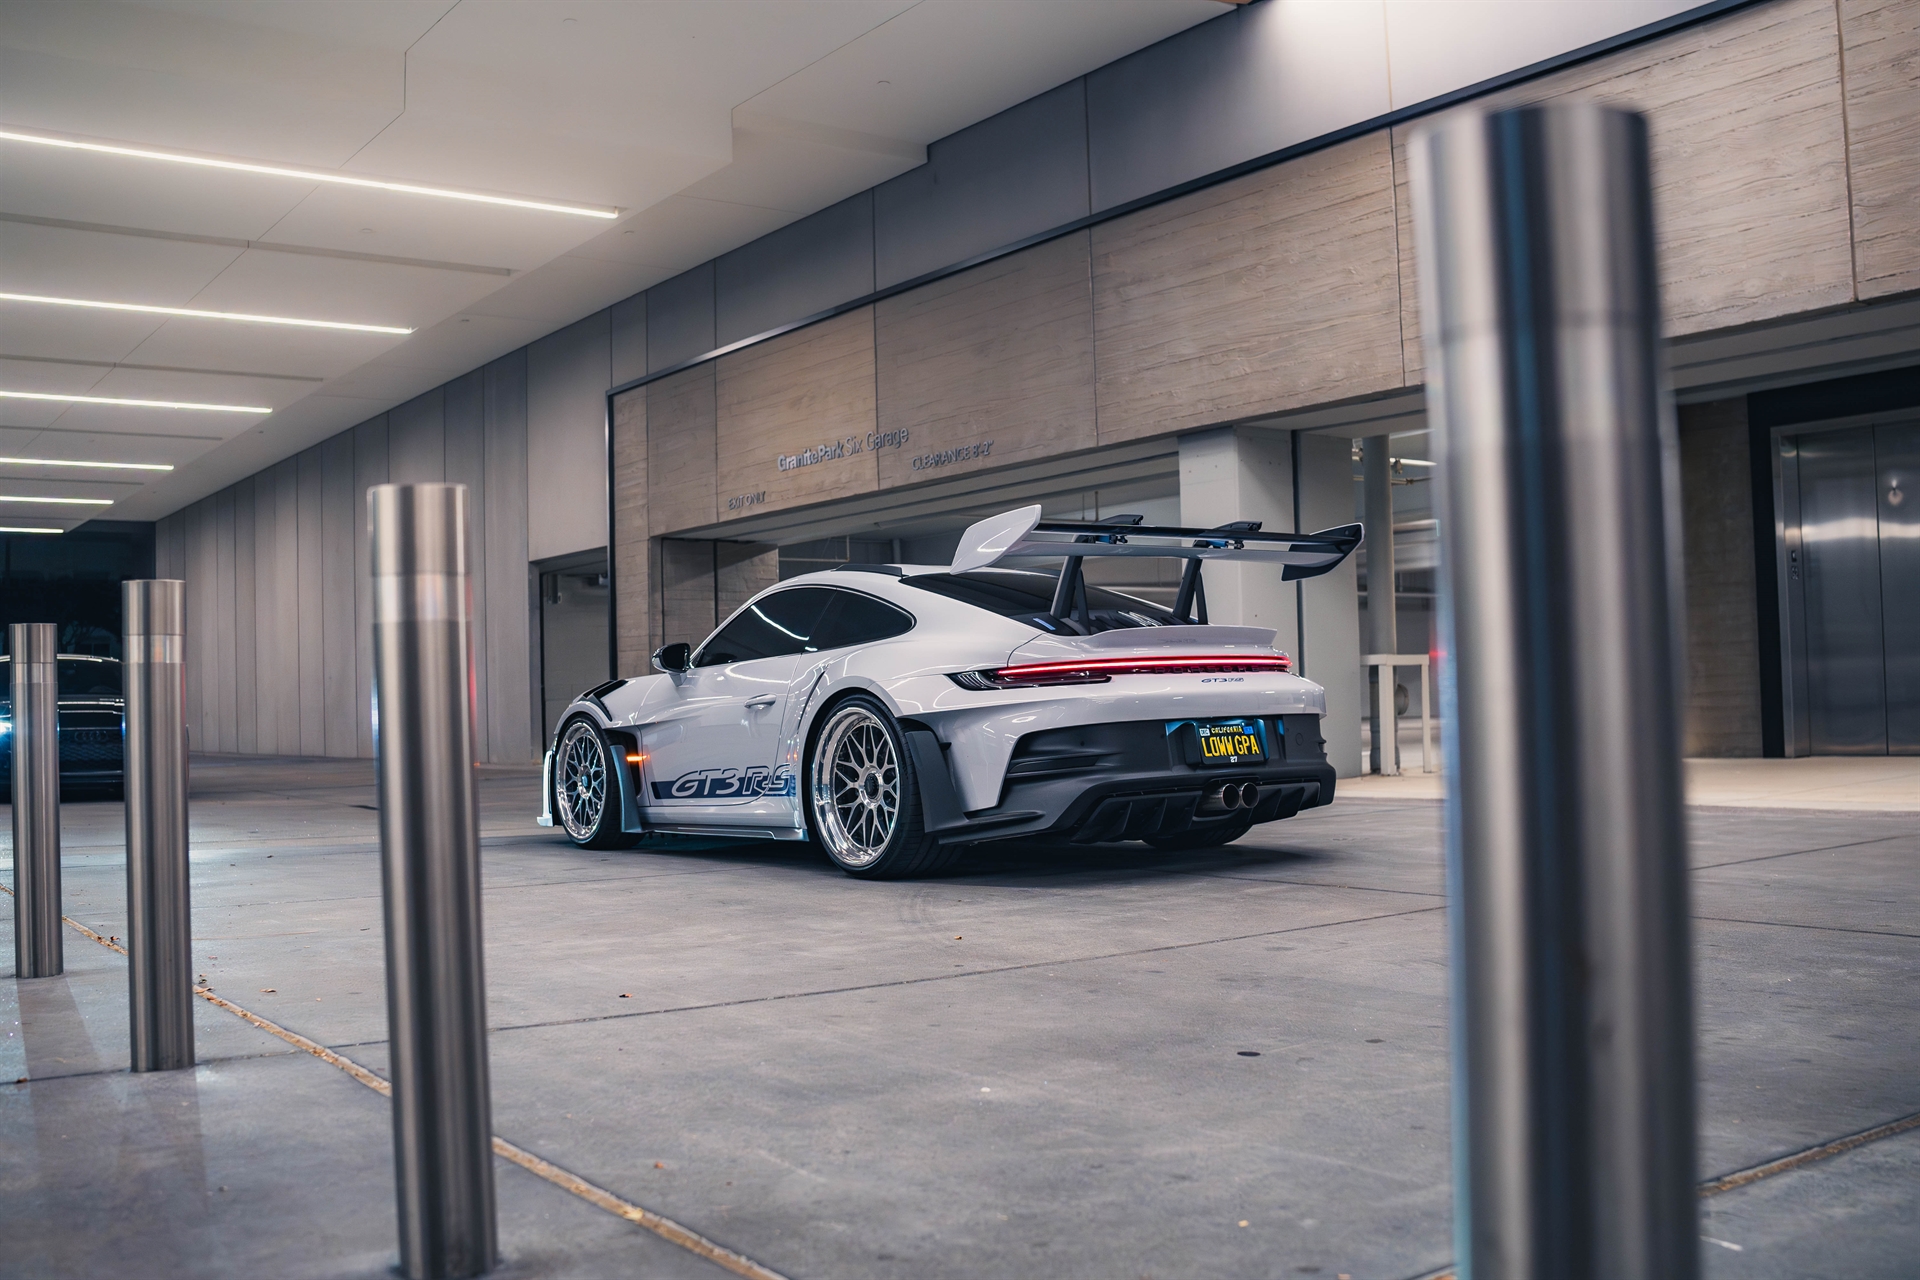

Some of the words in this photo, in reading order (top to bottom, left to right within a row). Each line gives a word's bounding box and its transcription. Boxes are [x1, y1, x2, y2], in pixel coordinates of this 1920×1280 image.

[845, 436, 864, 457] Six
[866, 427, 909, 450] Garage
[912, 445, 970, 471] CLEARANCE
[728, 495, 744, 511] EXIT
[745, 490, 766, 506] ONLY
[1211, 725, 1243, 734] CALIFORNIA
[1201, 736, 1235, 757] LOWW
[1234, 735, 1260, 755] GPA
